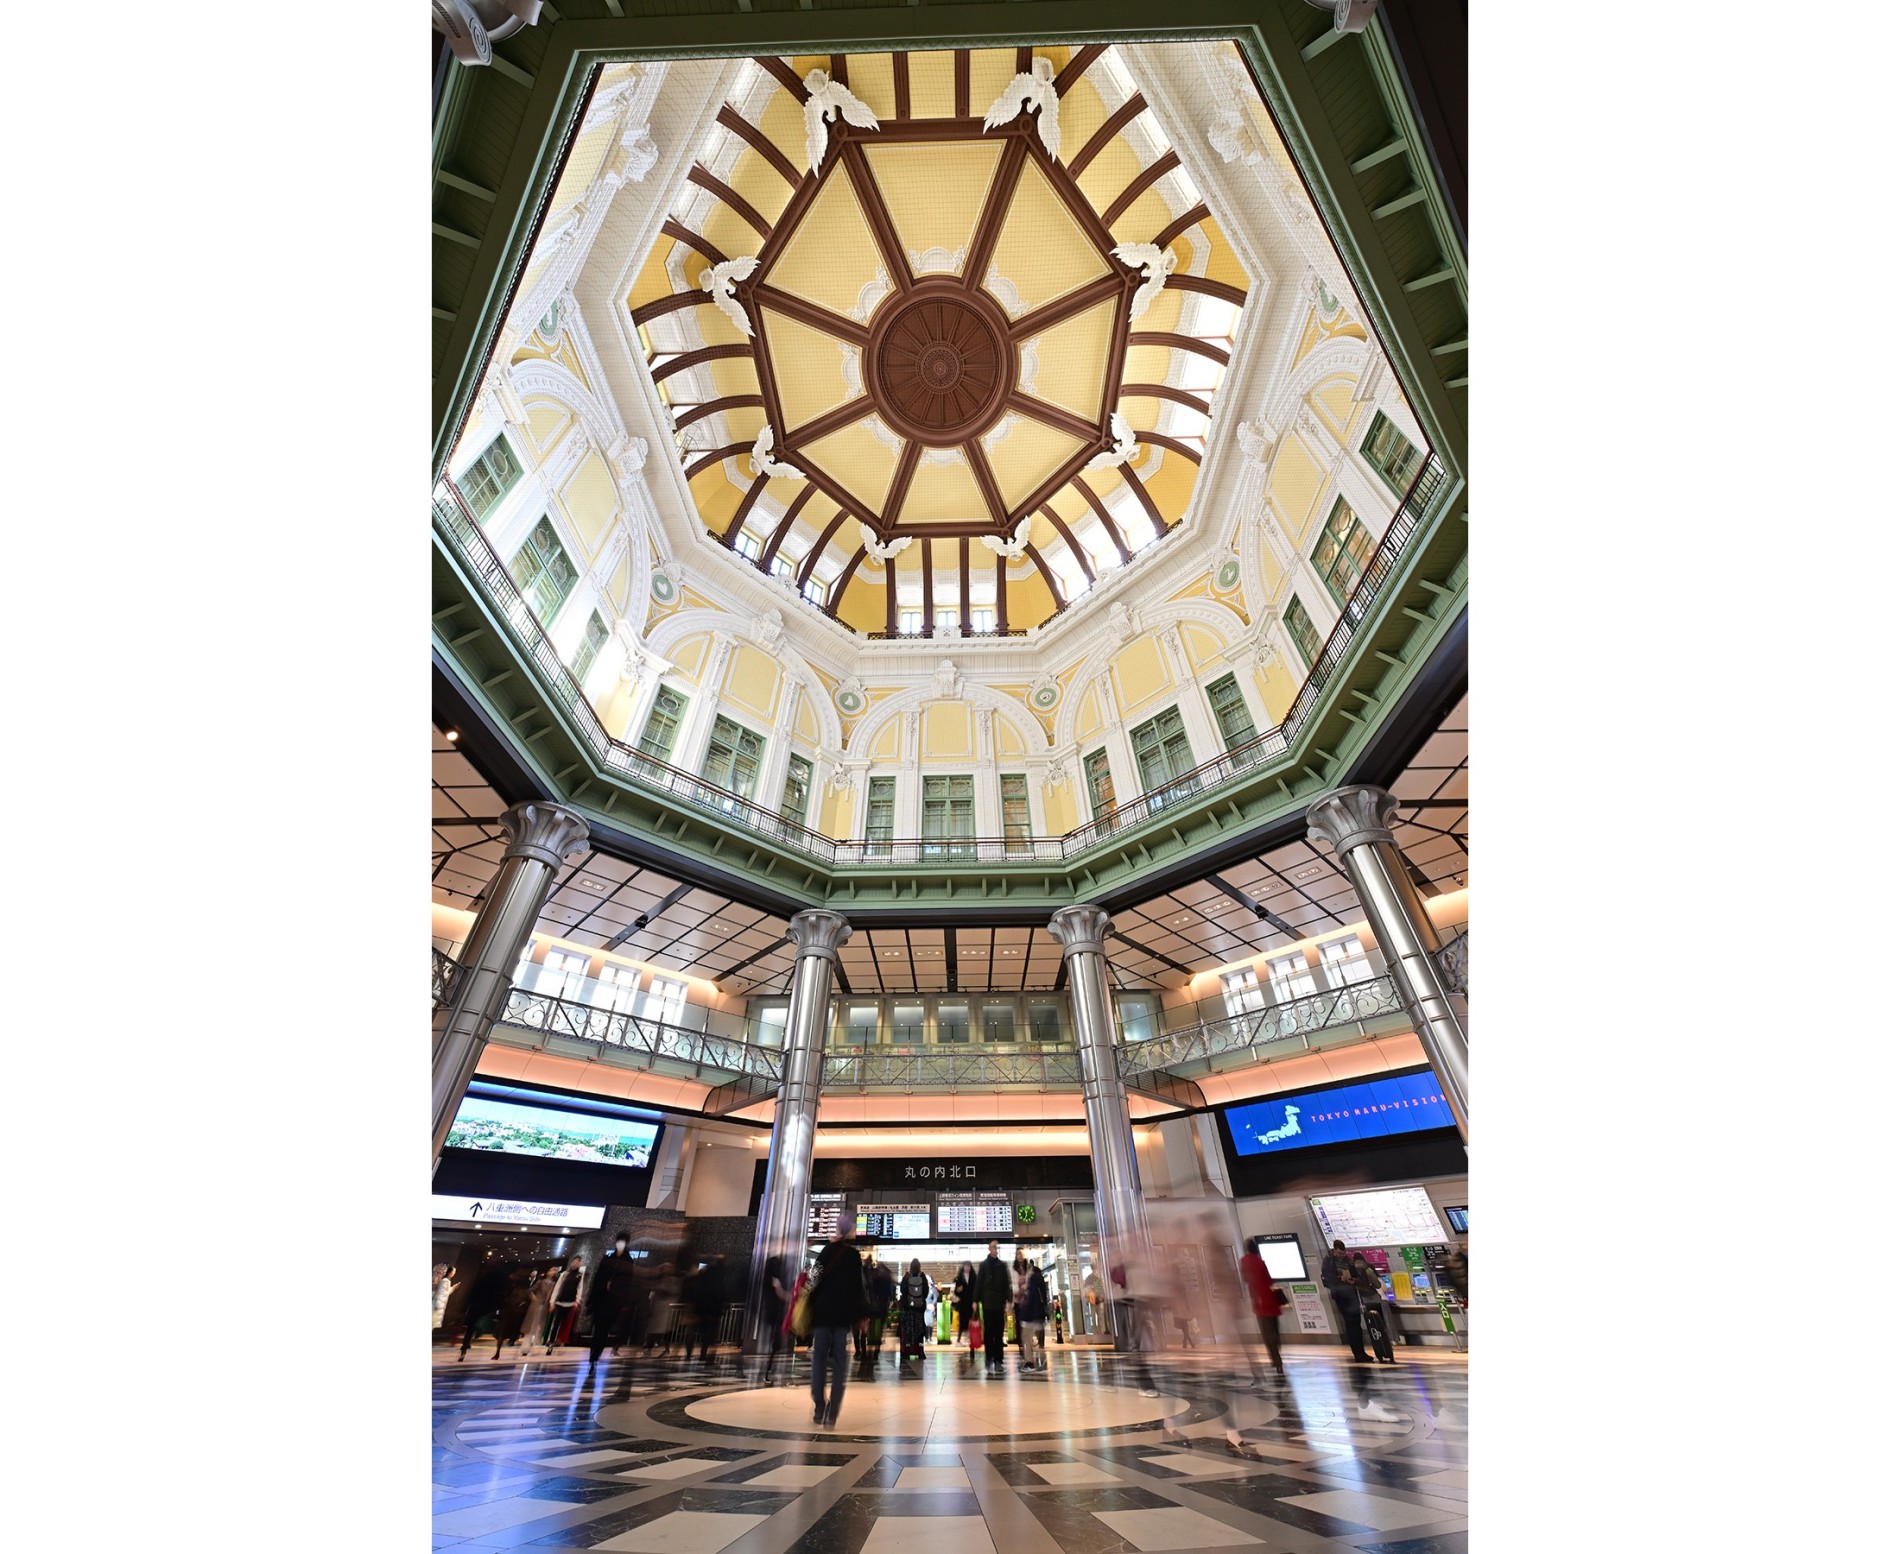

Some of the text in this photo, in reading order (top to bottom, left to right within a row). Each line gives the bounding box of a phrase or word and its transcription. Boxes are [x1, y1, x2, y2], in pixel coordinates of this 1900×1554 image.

[1311, 1110, 1349, 1122] TOKYO
[904, 1165, 976, 1179] 丸の内北口
[486, 1202, 569, 1217] 八重洲側への自由通路
